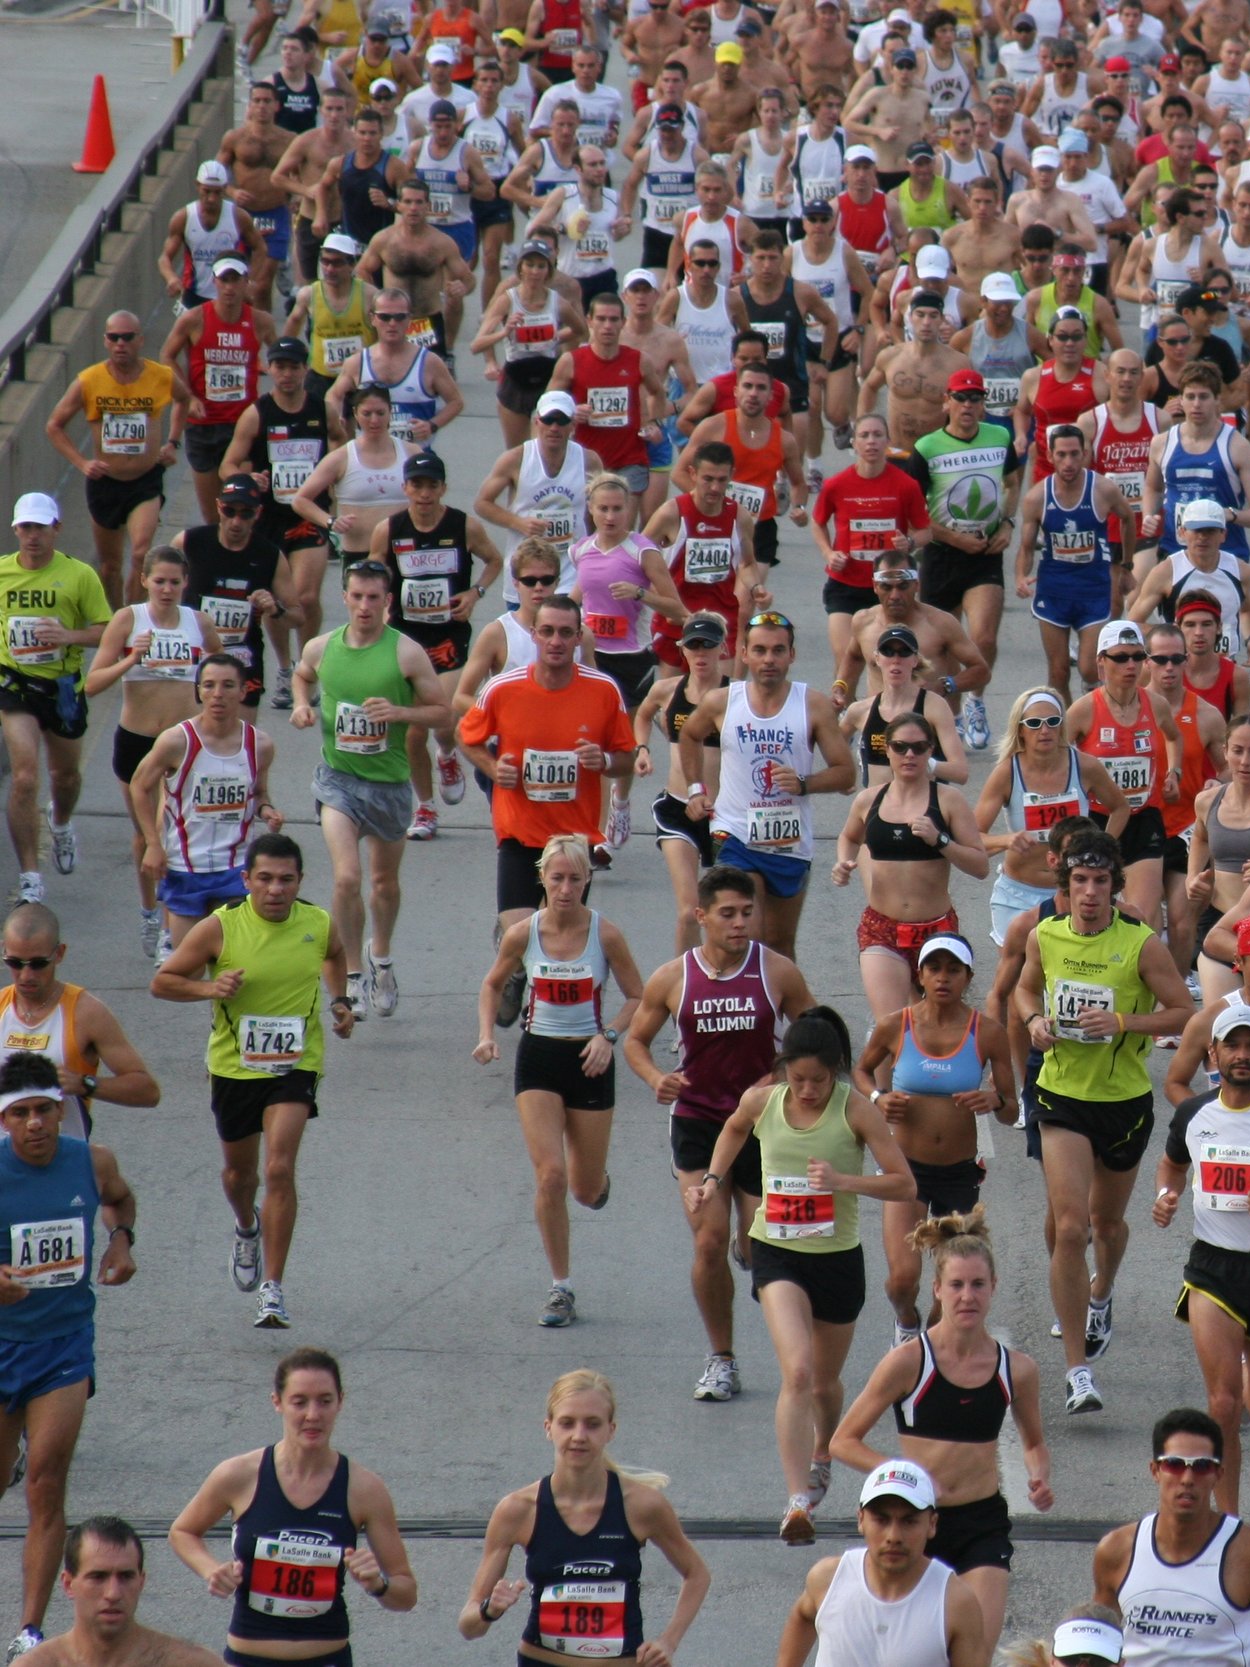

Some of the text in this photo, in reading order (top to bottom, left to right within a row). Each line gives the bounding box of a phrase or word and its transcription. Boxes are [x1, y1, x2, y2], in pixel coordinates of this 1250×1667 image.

[932, 79, 963, 94] IOWA
[659, 173, 681, 183] WEST
[217, 333, 241, 345] TEAM
[205, 348, 249, 361] NEBRASKA
[210, 374, 240, 388] A 691
[96, 396, 123, 406] DICK
[103, 423, 145, 439] A 1790
[276, 443, 316, 458] OSCAR
[943, 449, 1006, 468] HERBALIFE
[1102, 445, 1148, 463] Japan
[533, 486, 575, 503] DAYTONA
[1052, 532, 1093, 547] A 1716
[407, 553, 447, 566] JORGE
[689, 549, 728, 566] 24404
[7, 590, 56, 608] PERU
[407, 590, 443, 608] A 627
[215, 612, 248, 628] 1167
[156, 641, 190, 660] 1125
[740, 729, 793, 744] FRANCE
[754, 743, 782, 754] AFCF
[523, 765, 576, 783] A 1016
[1112, 770, 1148, 789] 1981
[192, 786, 245, 803] A 1965
[750, 820, 800, 841] A 1028
[570, 966, 584, 974] Bank
[546, 982, 579, 1001] 166
[693, 998, 755, 1015] LOYOLA
[697, 1016, 755, 1032] ALUMNI
[245, 1033, 294, 1053] A 742
[922, 1064, 952, 1073] IMPALA
[1219, 1149, 1238, 1157] LaSalle
[1212, 1166, 1246, 1192] 206
[780, 1199, 815, 1221] 316
[20, 1236, 74, 1266] A 681
[279, 1530, 331, 1547] Pacers
[282, 1548, 332, 1559] LaSalle Bank
[562, 1564, 612, 1577] Pacers
[272, 1568, 315, 1597] 186
[567, 1585, 616, 1593] LaSalle Bank
[561, 1607, 603, 1634] 189
[1137, 1606, 1218, 1625] RUNNER'S
[1073, 1625, 1101, 1635] BOSTON
[1134, 1623, 1194, 1640] SOURCE
